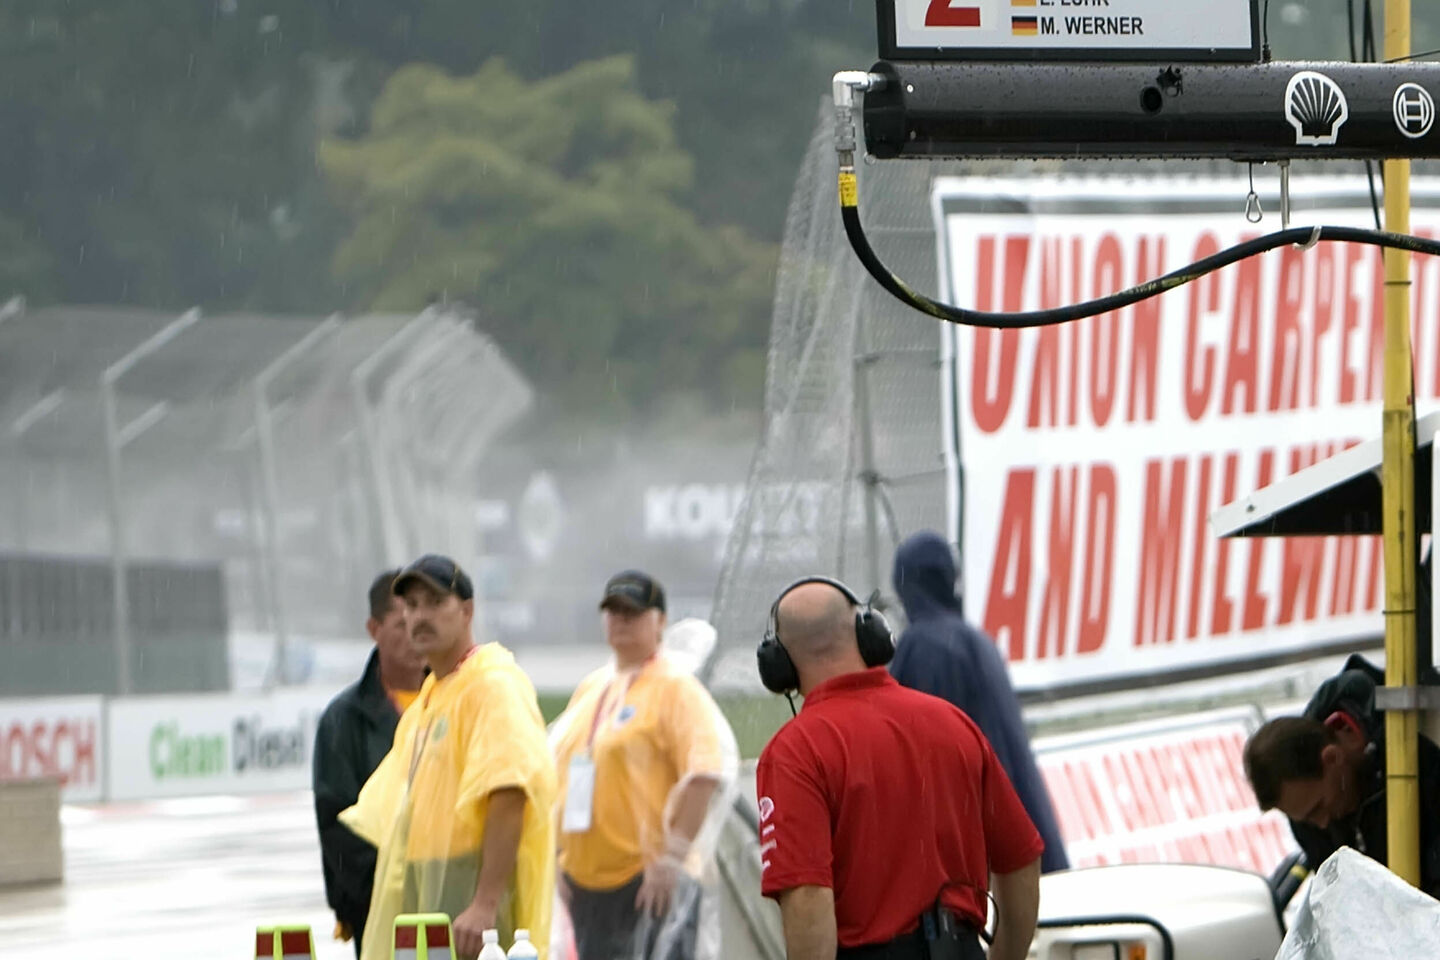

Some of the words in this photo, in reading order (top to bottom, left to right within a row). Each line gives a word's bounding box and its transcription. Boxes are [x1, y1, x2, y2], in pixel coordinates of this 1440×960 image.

[1041, 17, 1060, 35] M.
[1065, 17, 1144, 35] WERNER
[970, 232, 1167, 433] UNION
[981, 460, 1119, 662] AND
[0, 718, 96, 789] OSCH
[150, 719, 228, 778] Clean
